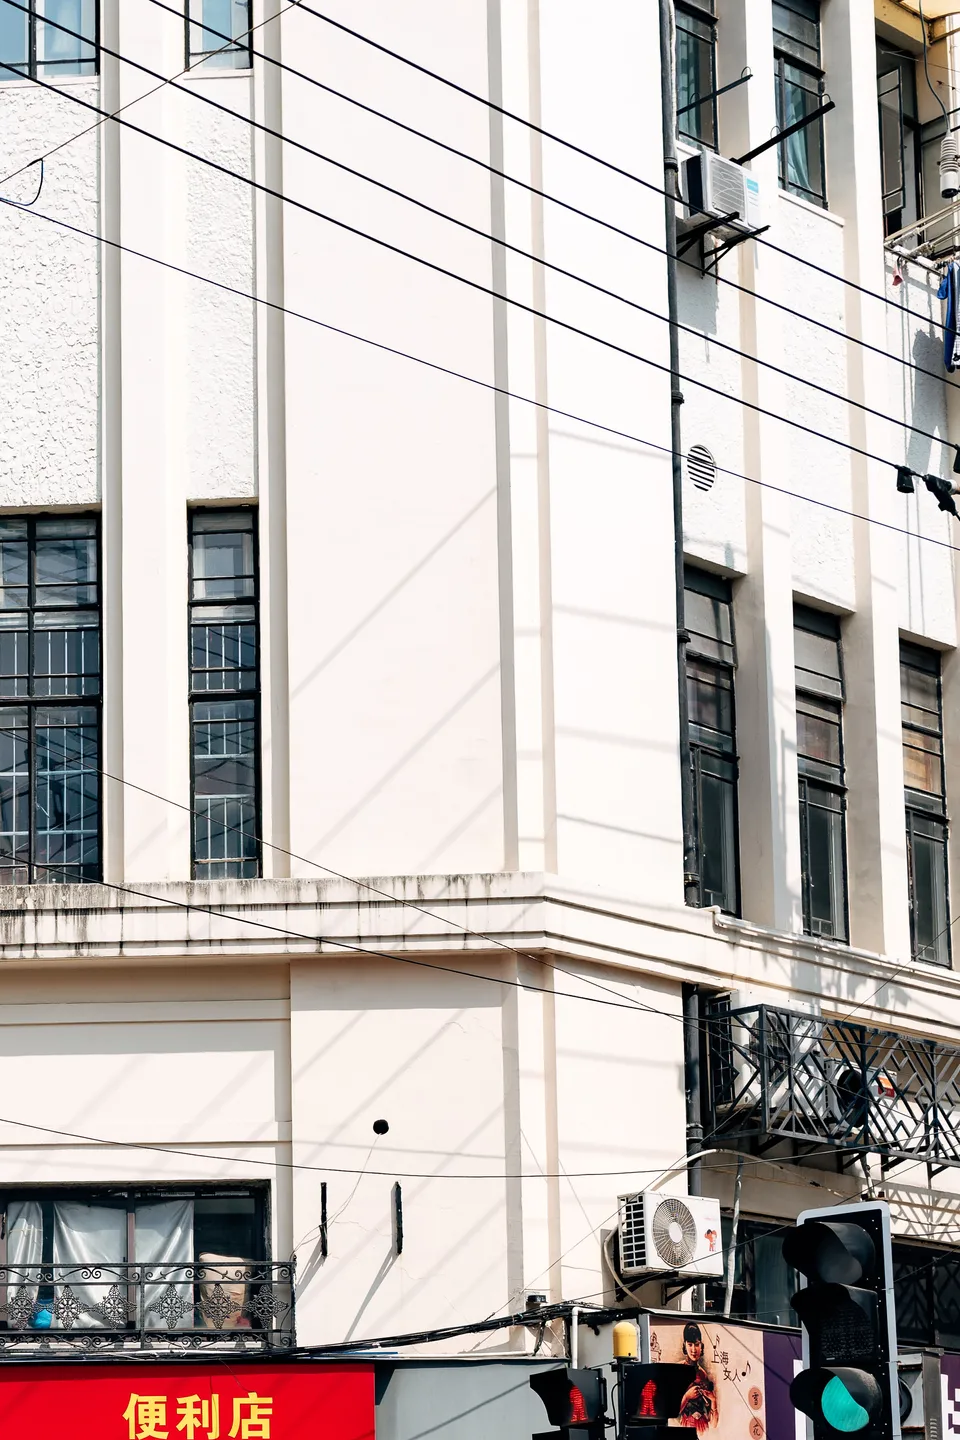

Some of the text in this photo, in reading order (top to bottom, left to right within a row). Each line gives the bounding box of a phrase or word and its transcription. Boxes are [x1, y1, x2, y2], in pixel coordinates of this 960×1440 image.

[711, 1350, 729, 1365] 上海
[723, 1368, 741, 1382] 女人
[122, 1391, 274, 1440] 便利店
